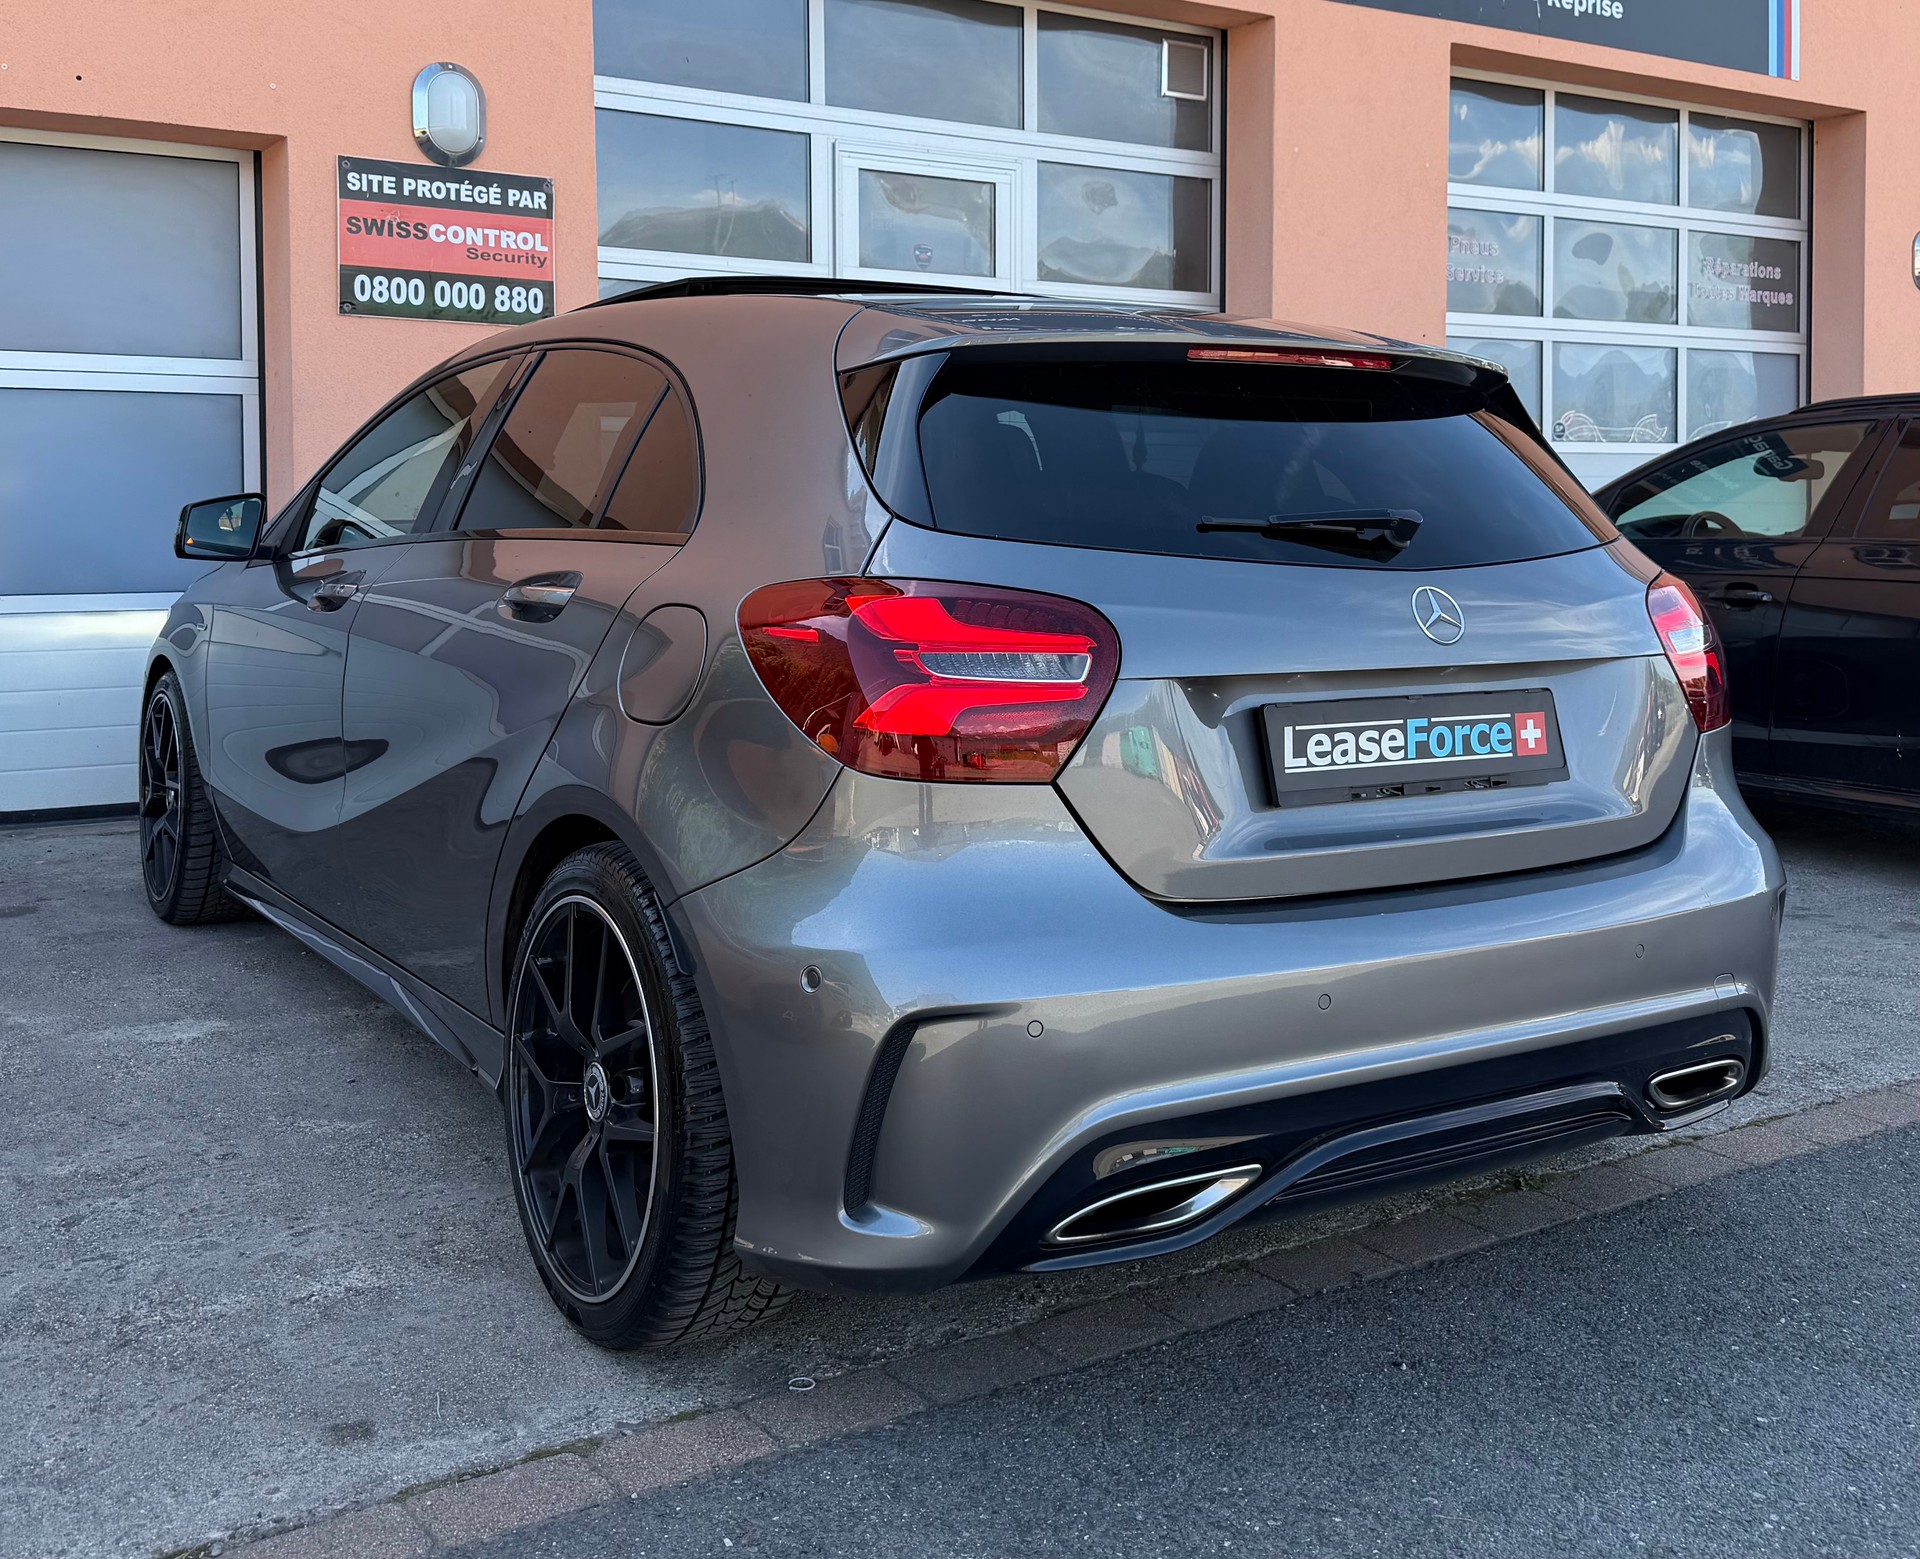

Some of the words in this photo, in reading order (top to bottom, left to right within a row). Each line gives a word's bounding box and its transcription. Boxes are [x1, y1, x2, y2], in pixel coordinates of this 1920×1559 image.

[347, 172, 397, 195] SITE
[403, 178, 502, 206] PROTÉGÉ
[508, 189, 547, 210] PAR
[466, 247, 548, 269] Security
[1702, 256, 1782, 280] Réparations
[354, 274, 425, 305] 0800
[434, 280, 486, 310] 000
[494, 285, 544, 314] 880
[1284, 717, 1513, 768] LeaseForce
